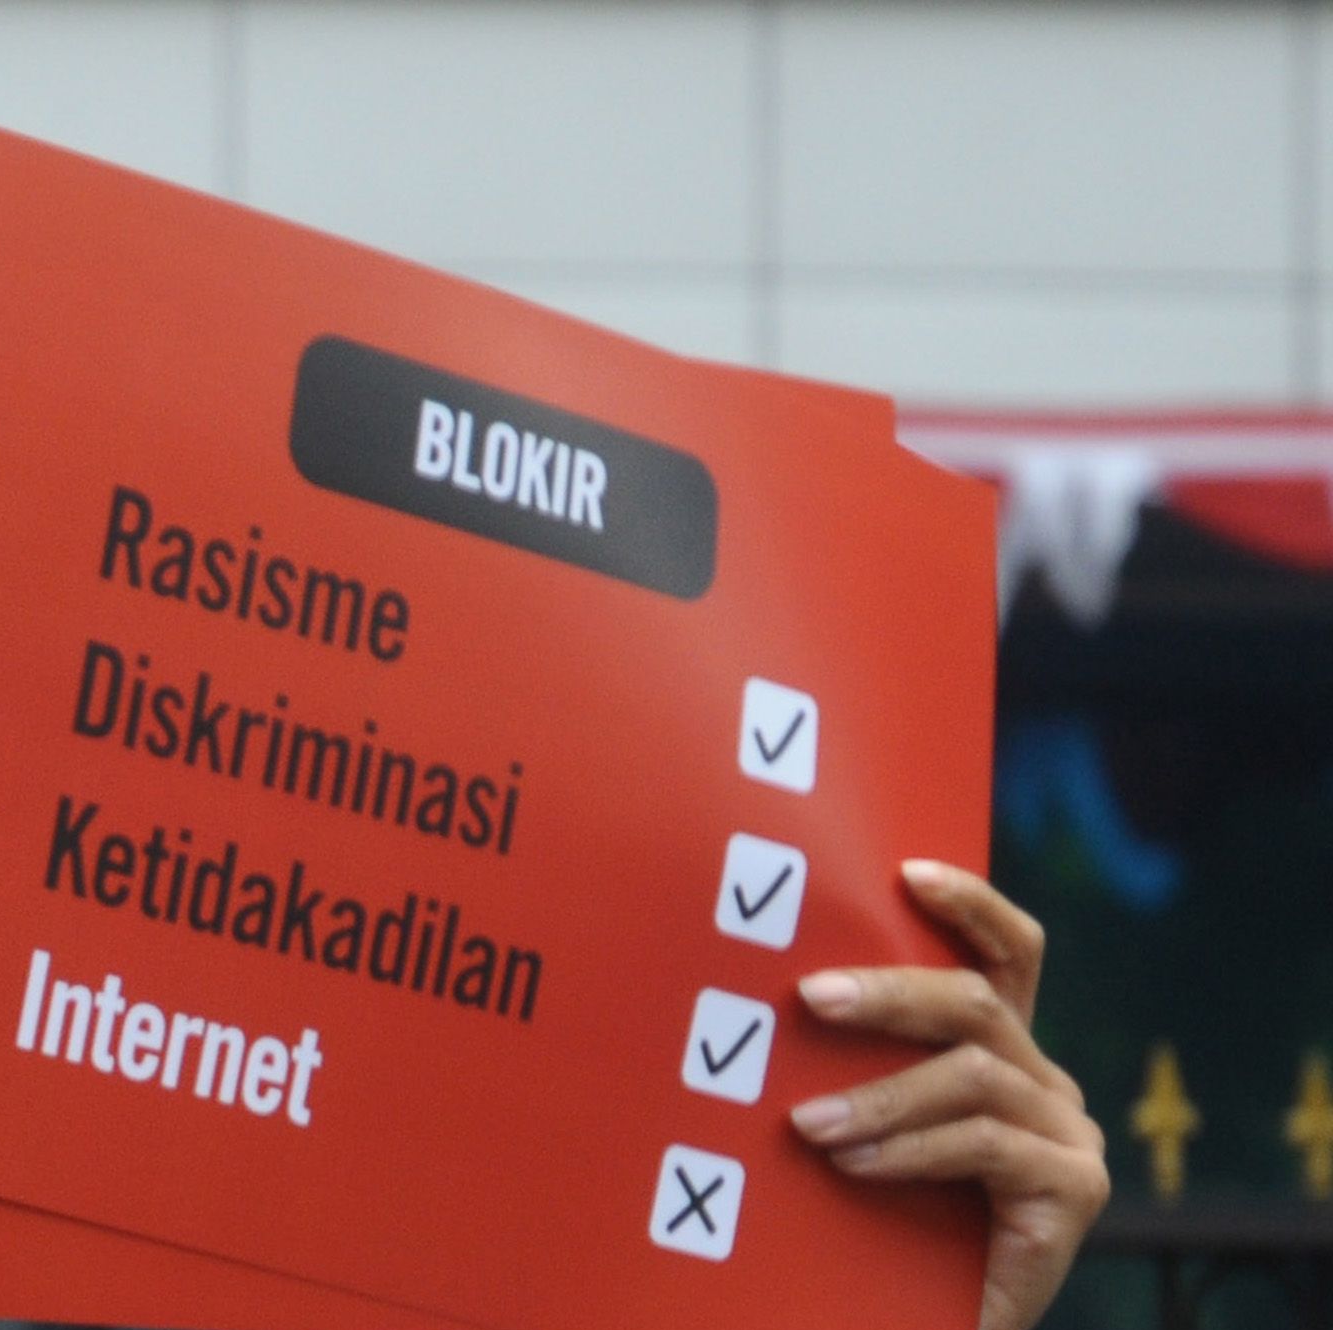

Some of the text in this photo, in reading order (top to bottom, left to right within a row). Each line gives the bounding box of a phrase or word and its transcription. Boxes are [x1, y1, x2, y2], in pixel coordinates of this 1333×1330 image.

[414, 398, 608, 532] BLOKIR
[100, 486, 410, 663] Rasisme
[72, 639, 523, 856] Diskriminasi
[44, 795, 543, 1022] Ketidakadilan
[16, 949, 323, 1126] Internet
